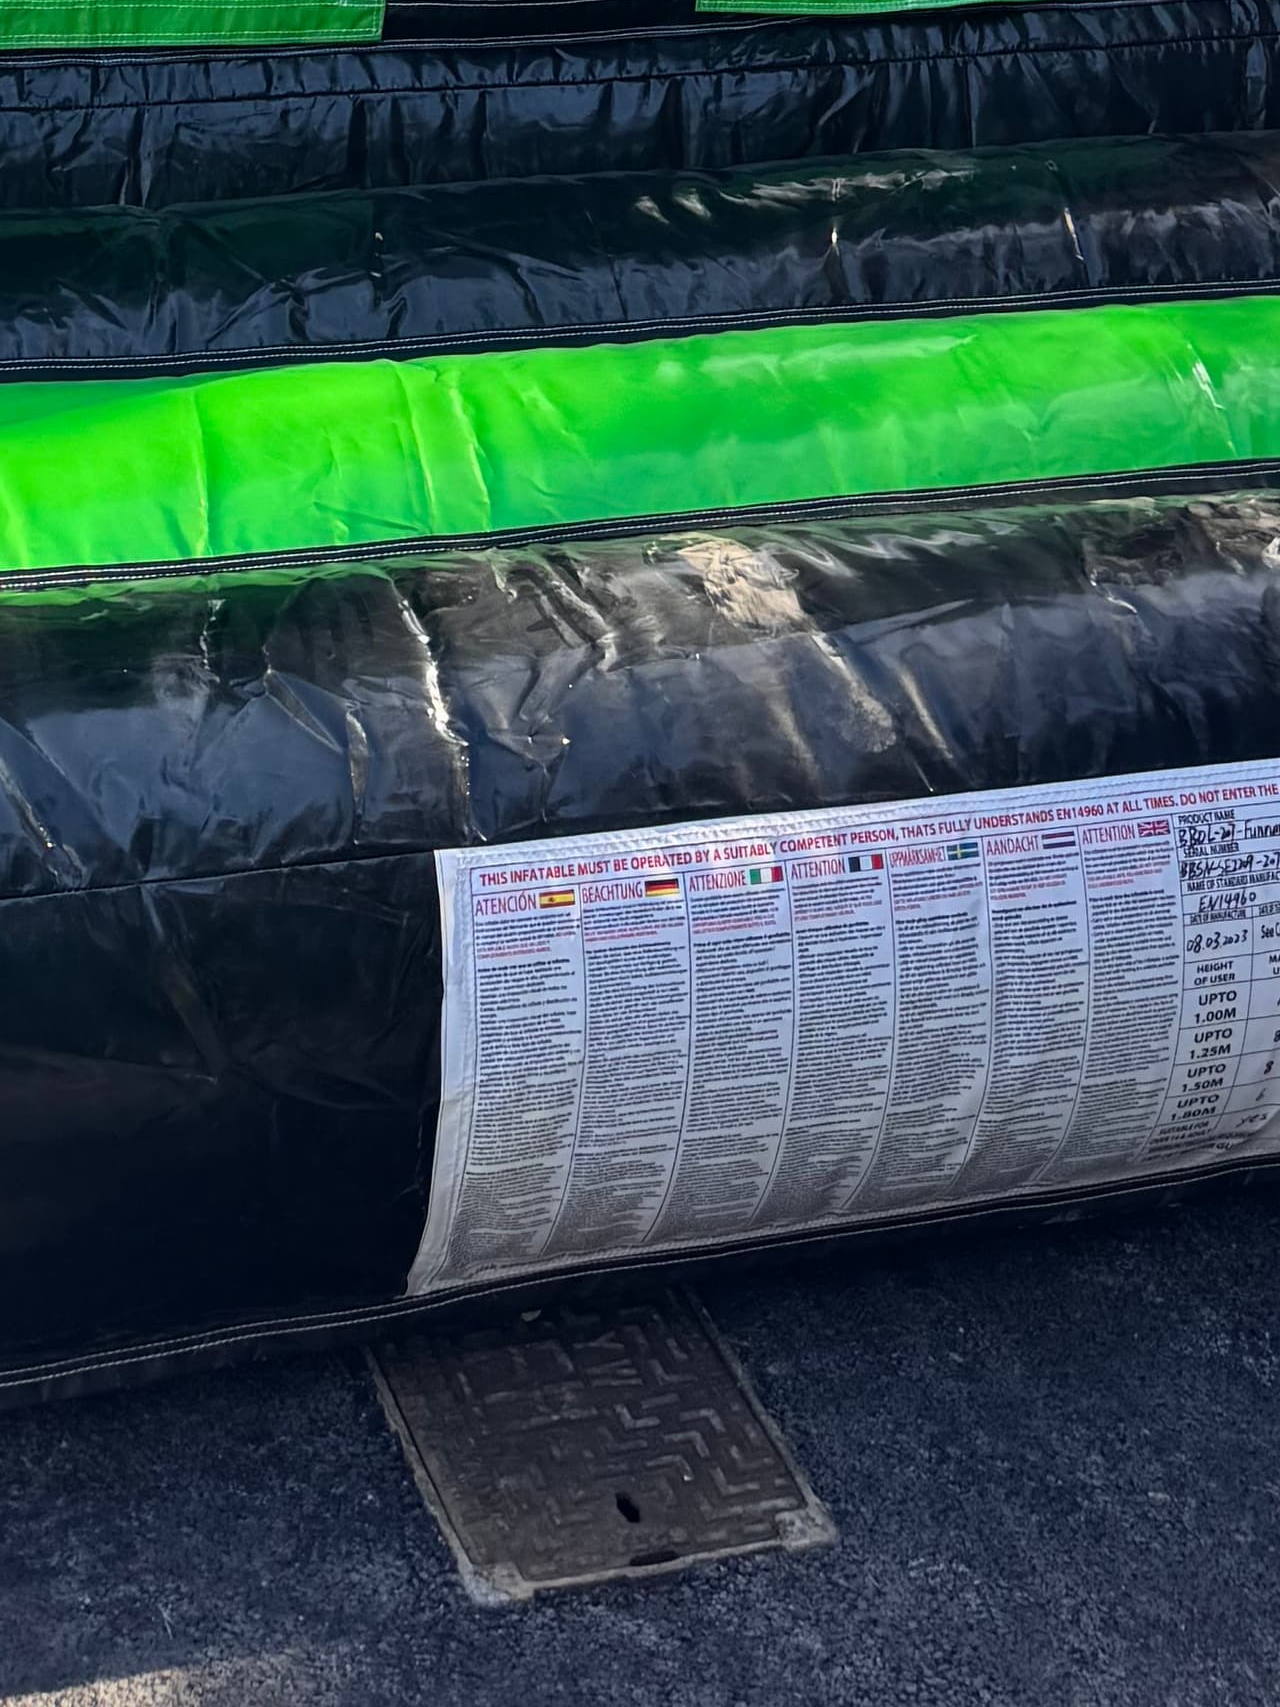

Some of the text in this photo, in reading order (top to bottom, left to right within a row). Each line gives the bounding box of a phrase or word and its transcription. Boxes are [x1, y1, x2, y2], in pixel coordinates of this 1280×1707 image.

[1178, 812, 1213, 825] PRODUCT
[479, 873, 508, 887] THIS
[510, 865, 575, 884] INFATABLE
[578, 860, 610, 876] MUST
[613, 859, 628, 872] BE
[631, 852, 692, 869] OPERATED
[695, 850, 710, 863] BY
[713, 849, 721, 861] A
[724, 841, 777, 860] SUITABLY
[779, 833, 847, 853] COMPETENT
[850, 829, 899, 845] PERSON,
[900, 823, 936, 839] THATS
[938, 818, 971, 835] FULLY
[973, 809, 1054, 830] UNDERSTANDS
[1056, 805, 1103, 820] EN14960
[1106, 801, 1119, 815] AT
[1122, 798, 1142, 813] ALL
[1143, 794, 1179, 810] TIMES.
[1180, 792, 1195, 806] DO
[1199, 790, 1220, 804] NOT
[1221, 786, 1255, 802] ENTER
[1258, 783, 1279, 797] THE
[1082, 823, 1136, 844] ATTENTION
[986, 835, 1040, 856] AANDACHT
[791, 858, 846, 879] ATTENTION
[689, 870, 747, 892] ATTENZIONE
[582, 881, 643, 904] BEACHTUNG
[475, 891, 537, 916] ATENCIÓN
[1261, 925, 1274, 939] See
[1196, 961, 1234, 973] HEIGHT
[1194, 973, 1235, 986] OF USER
[1198, 990, 1237, 1006] UPTO
[1194, 1007, 1237, 1024] 1.00M
[1194, 1028, 1233, 1044] UPTO
[1190, 1044, 1231, 1060] 1.25M
[1187, 1063, 1226, 1078] UPTO
[1182, 1077, 1224, 1093] 1.50M
[1177, 1094, 1220, 1109] UPTO
[1171, 1106, 1216, 1121] 1.80M
